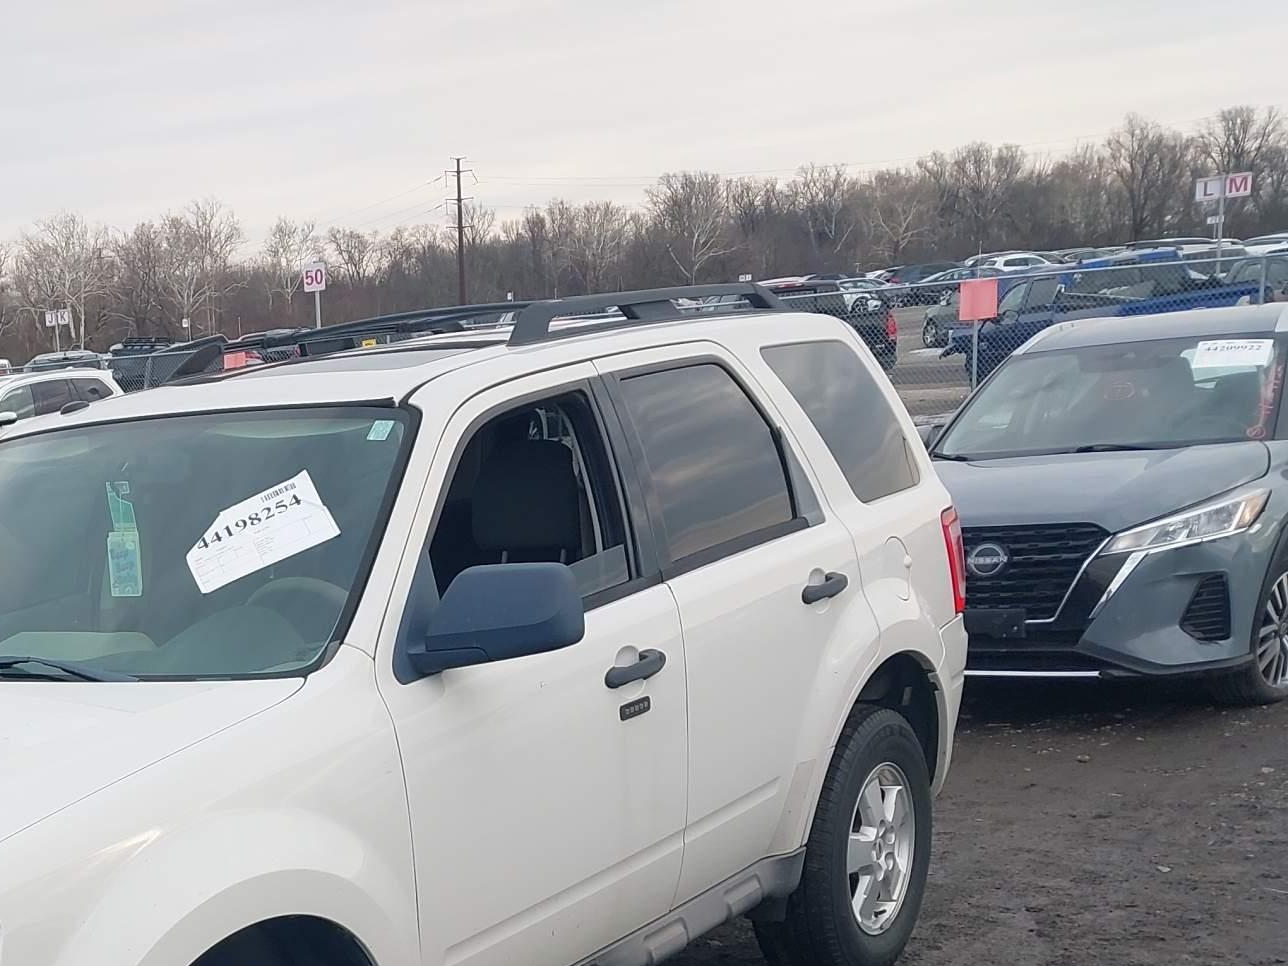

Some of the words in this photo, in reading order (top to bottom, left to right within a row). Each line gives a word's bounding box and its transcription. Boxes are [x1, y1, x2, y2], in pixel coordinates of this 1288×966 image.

[1204, 182, 1215, 196] L
[1228, 176, 1248, 193] M
[305, 269, 323, 286] 50
[197, 494, 302, 550] 44198254
